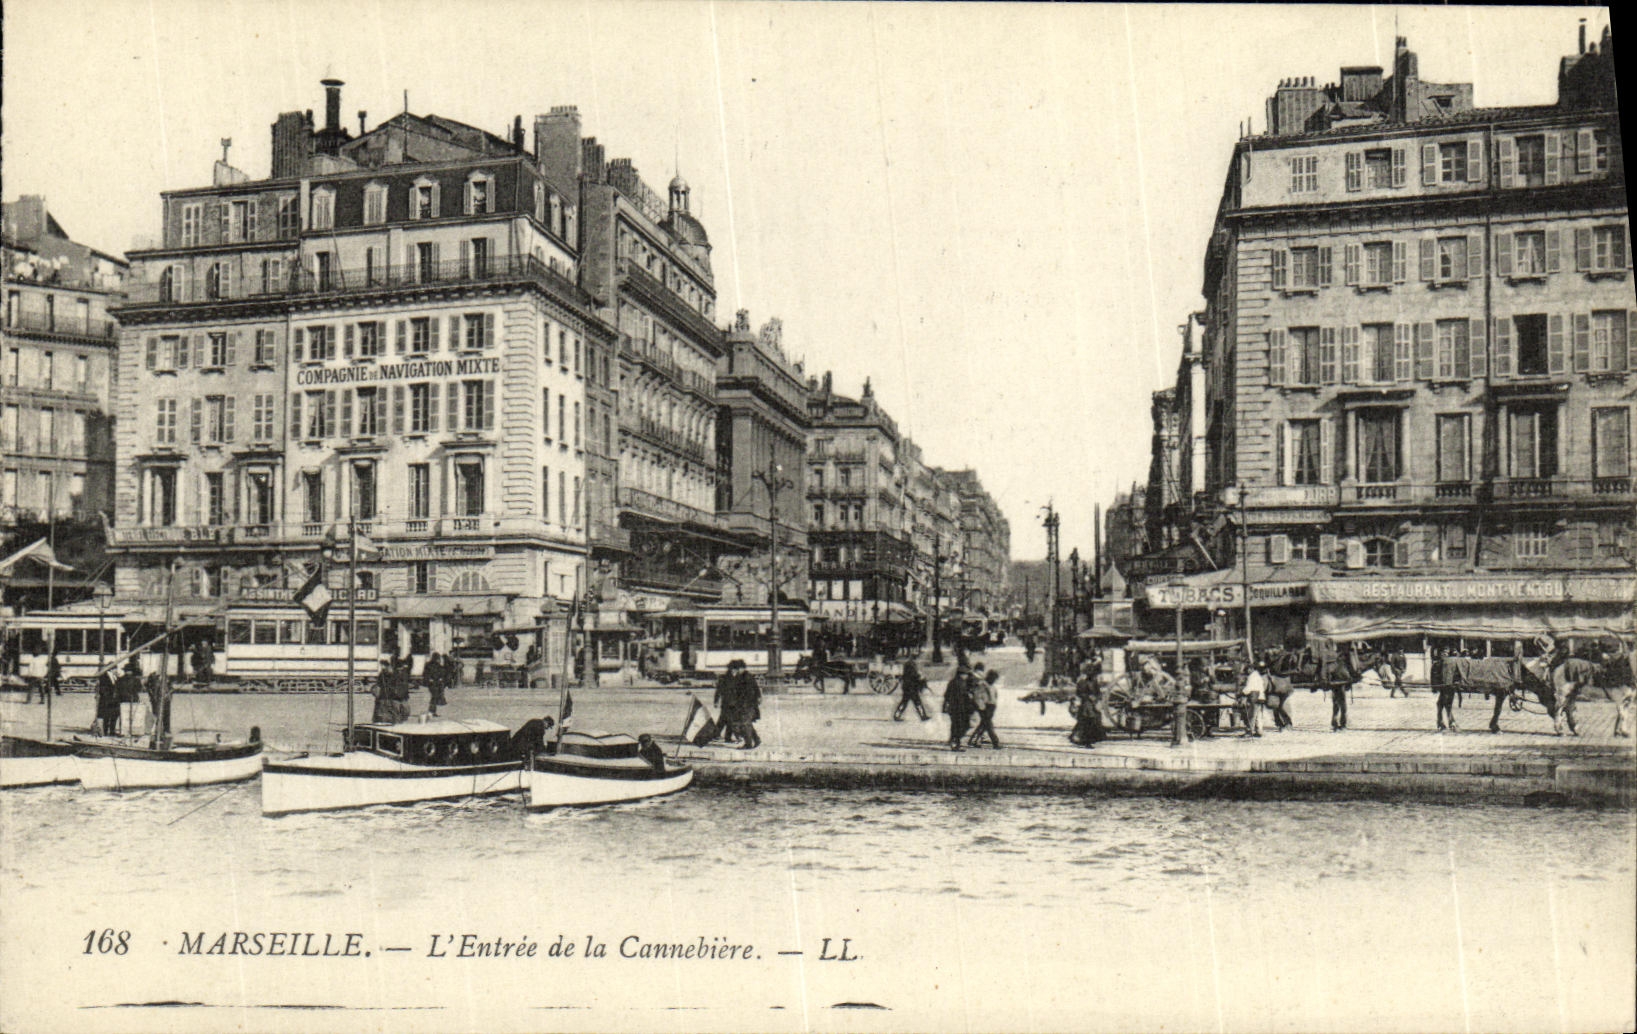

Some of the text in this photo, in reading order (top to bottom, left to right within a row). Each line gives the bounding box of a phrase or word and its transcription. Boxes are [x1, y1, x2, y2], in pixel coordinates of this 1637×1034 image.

[296, 364, 368, 385] COMPAGNIE
[380, 360, 453, 379] NAVIGATION
[456, 357, 500, 375] MIXTE
[1363, 583, 1450, 598] RESTAURANT
